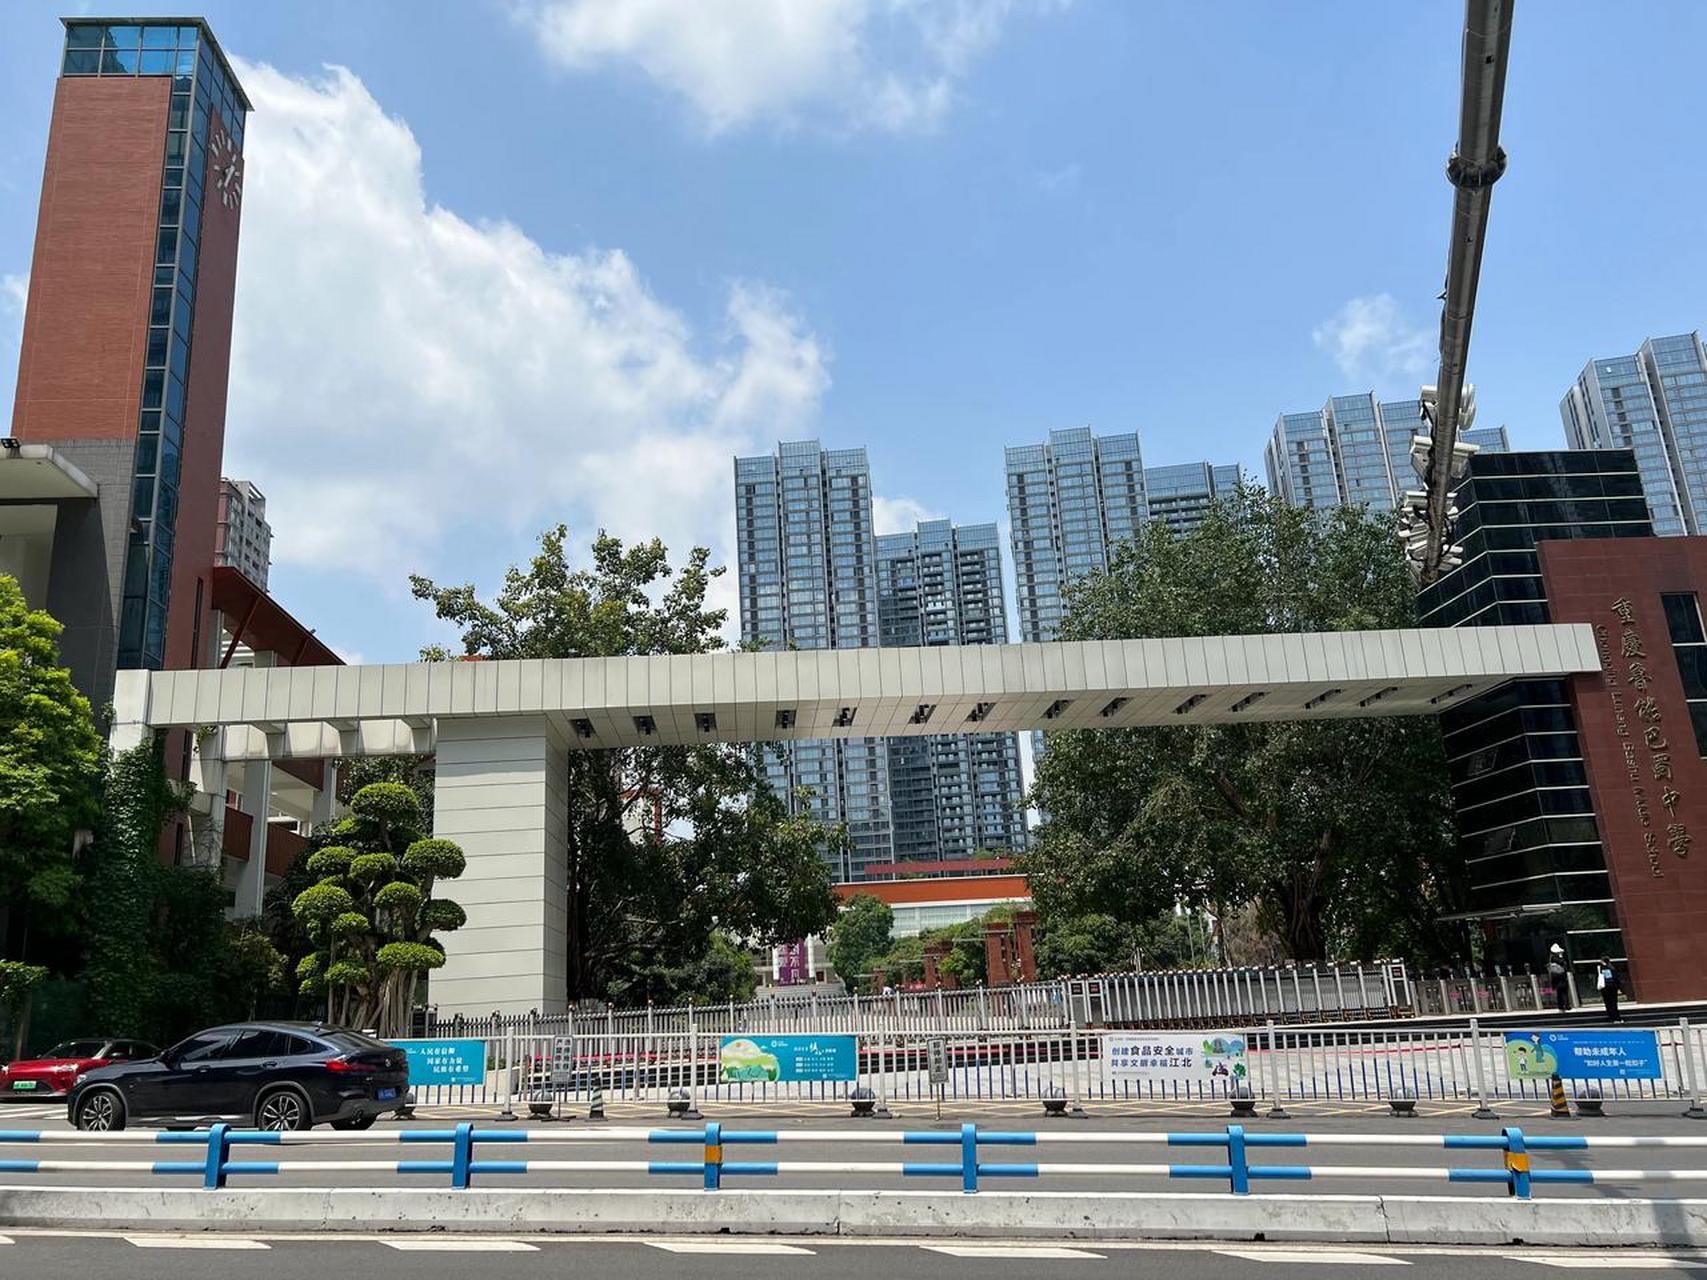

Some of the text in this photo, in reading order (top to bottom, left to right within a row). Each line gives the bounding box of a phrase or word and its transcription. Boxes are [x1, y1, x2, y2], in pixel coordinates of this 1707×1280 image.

[1643, 832, 1664, 879] School
[1112, 1046, 1193, 1056] 创建食品安全城市
[1573, 1047, 1627, 1056] 帮助未成年人
